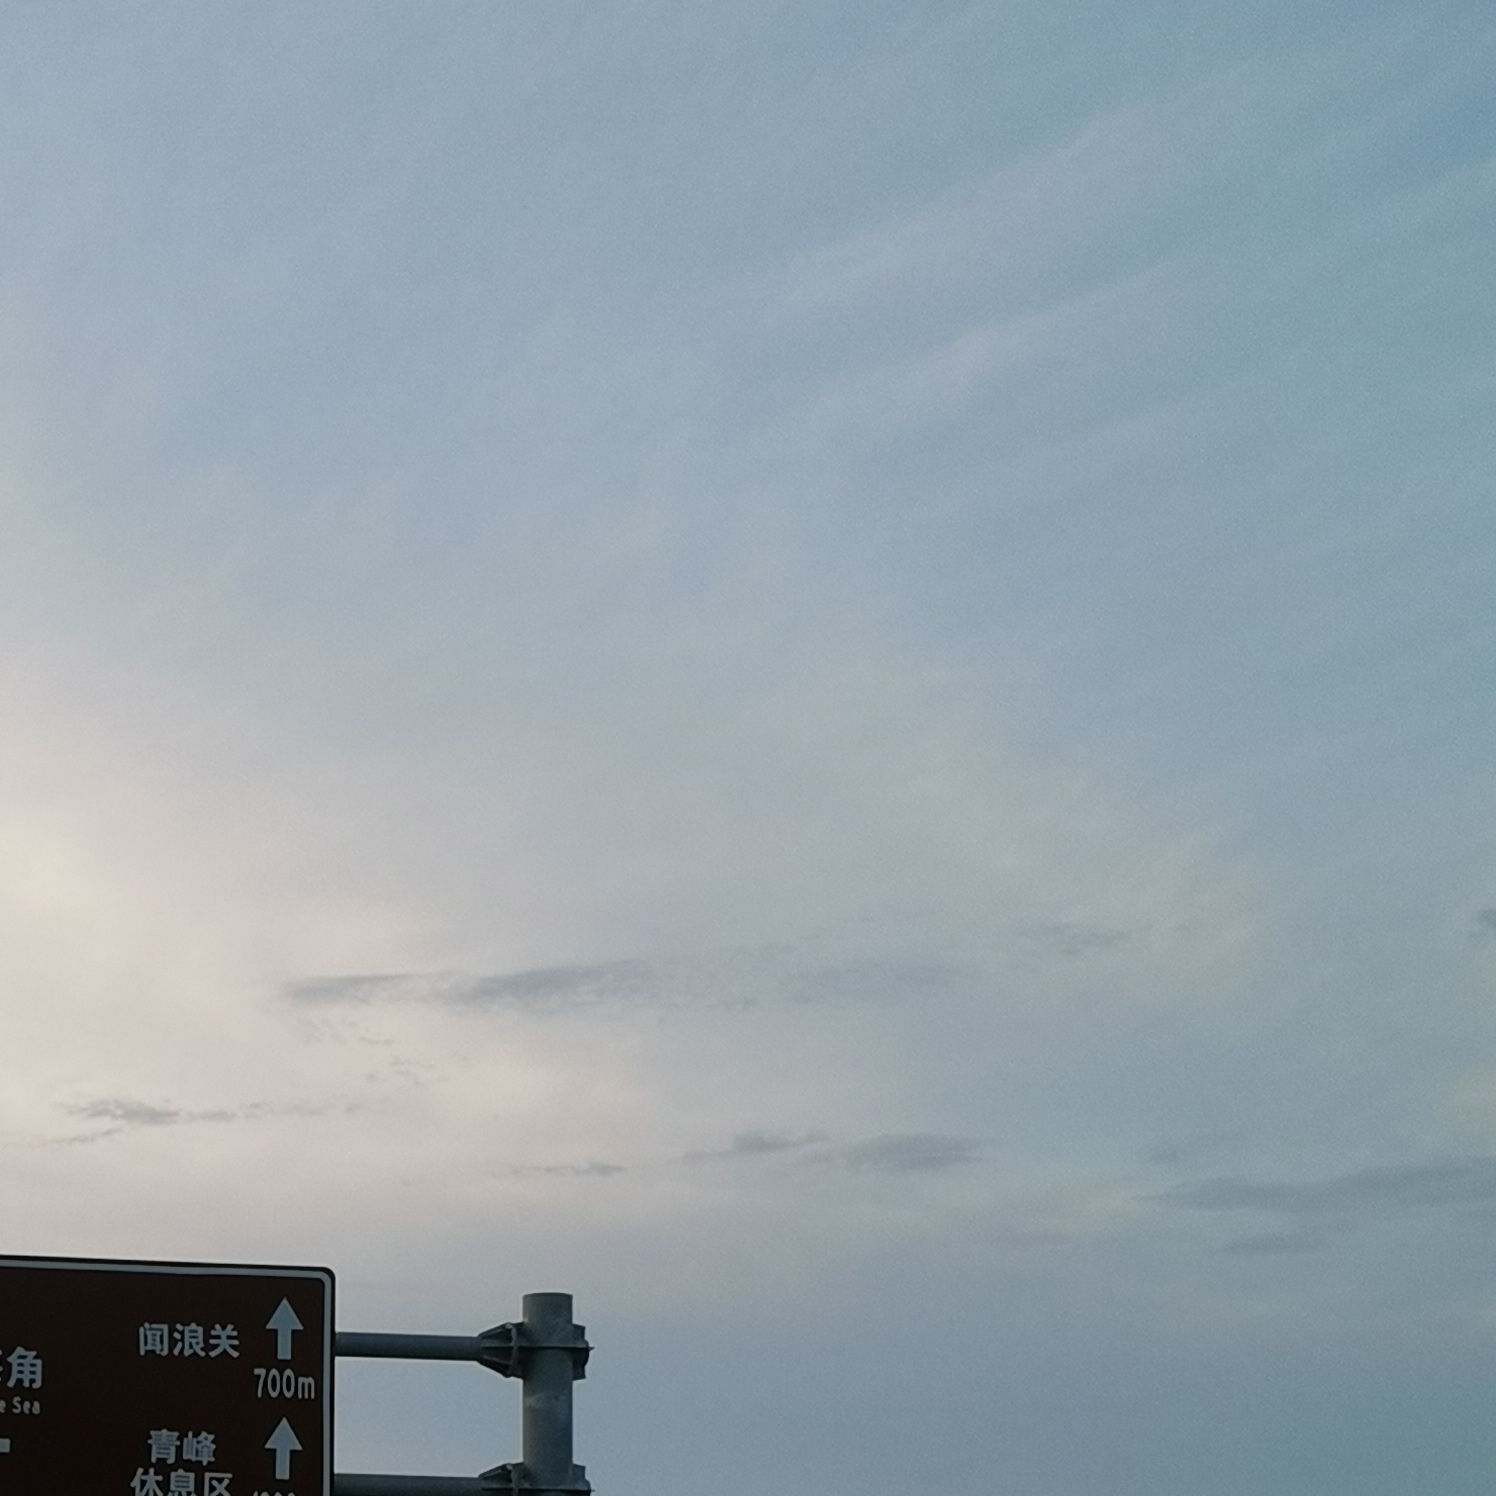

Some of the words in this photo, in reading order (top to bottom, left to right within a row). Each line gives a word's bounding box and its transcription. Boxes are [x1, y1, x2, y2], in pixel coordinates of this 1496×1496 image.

[138, 1322, 240, 1358] 闻浪关
[253, 1368, 315, 1399] 700m
[11, 1396, 41, 1415] Sea
[148, 1428, 216, 1466] 青峰
